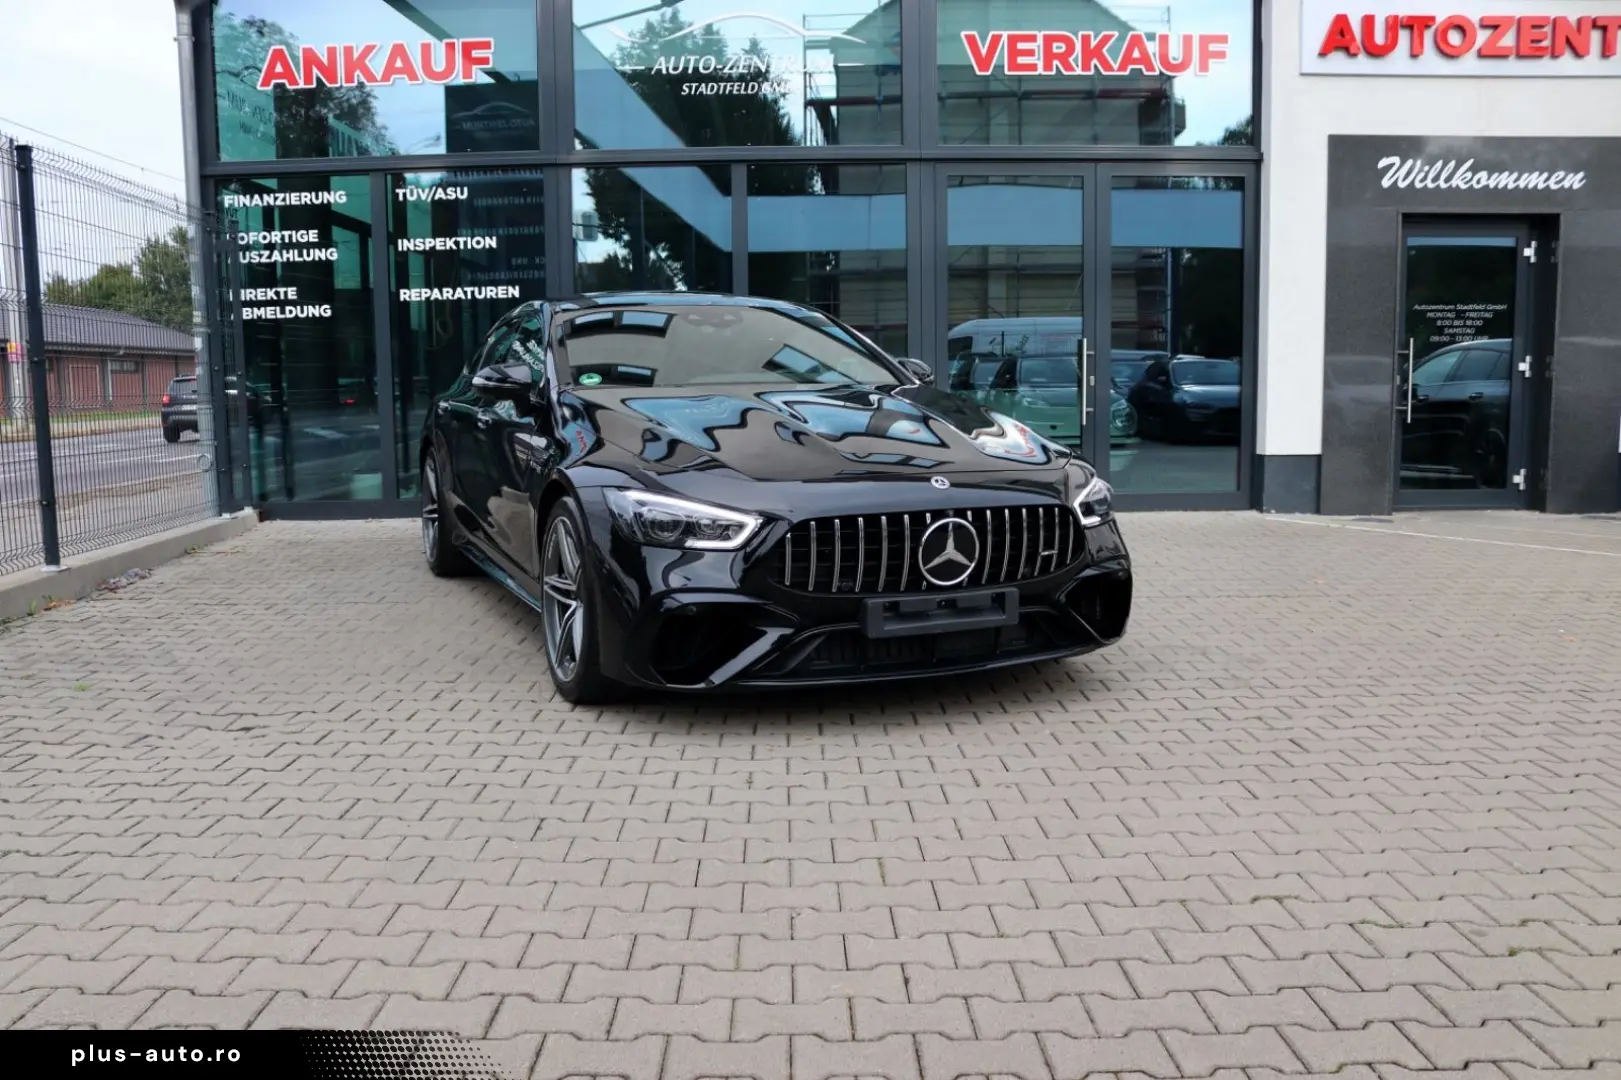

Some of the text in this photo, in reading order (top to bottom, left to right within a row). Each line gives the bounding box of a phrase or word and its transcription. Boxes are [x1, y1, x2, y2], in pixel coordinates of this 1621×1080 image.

[961, 31, 1229, 76] VERKAUF
[258, 38, 494, 90] ANKAUF
[651, 55, 833, 75] AUTO-ZENTR
[681, 82, 758, 95] STADTFELD
[1377, 156, 1586, 191] Willkommen
[224, 191, 347, 207] FINANZIERUNG
[395, 185, 468, 202] TÜV/ASU
[227, 230, 319, 245] OFORTIGE
[398, 236, 497, 251] INSPEKTION
[228, 248, 338, 263] USZAHLUNG
[230, 287, 297, 301] IREKTE
[400, 286, 520, 301] REPARATUREN
[231, 305, 332, 320] BMELDUNG
